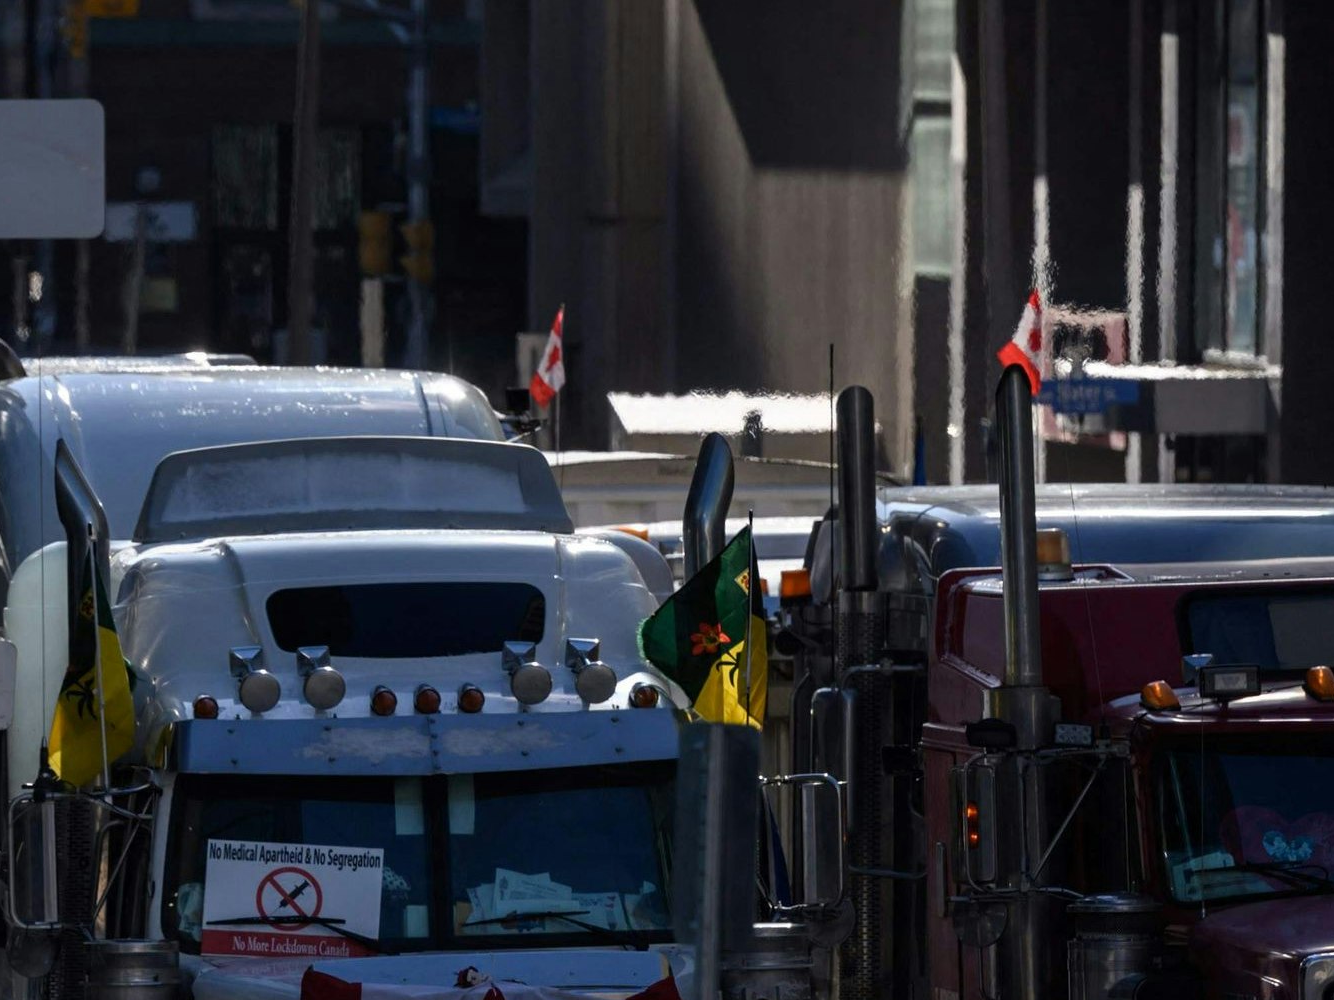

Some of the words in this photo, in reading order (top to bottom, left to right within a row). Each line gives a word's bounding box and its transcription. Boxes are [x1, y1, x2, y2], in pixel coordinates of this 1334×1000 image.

[210, 843, 222, 860] No
[223, 843, 258, 862] Medical
[259, 843, 303, 865] Apartheid
[305, 848, 311, 864] &
[313, 848, 326, 866] No
[327, 849, 381, 872] Segregation
[232, 936, 245, 951] No
[247, 936, 269, 952] More
[271, 937, 317, 955] Lockdowns
[318, 941, 350, 957] Canada
